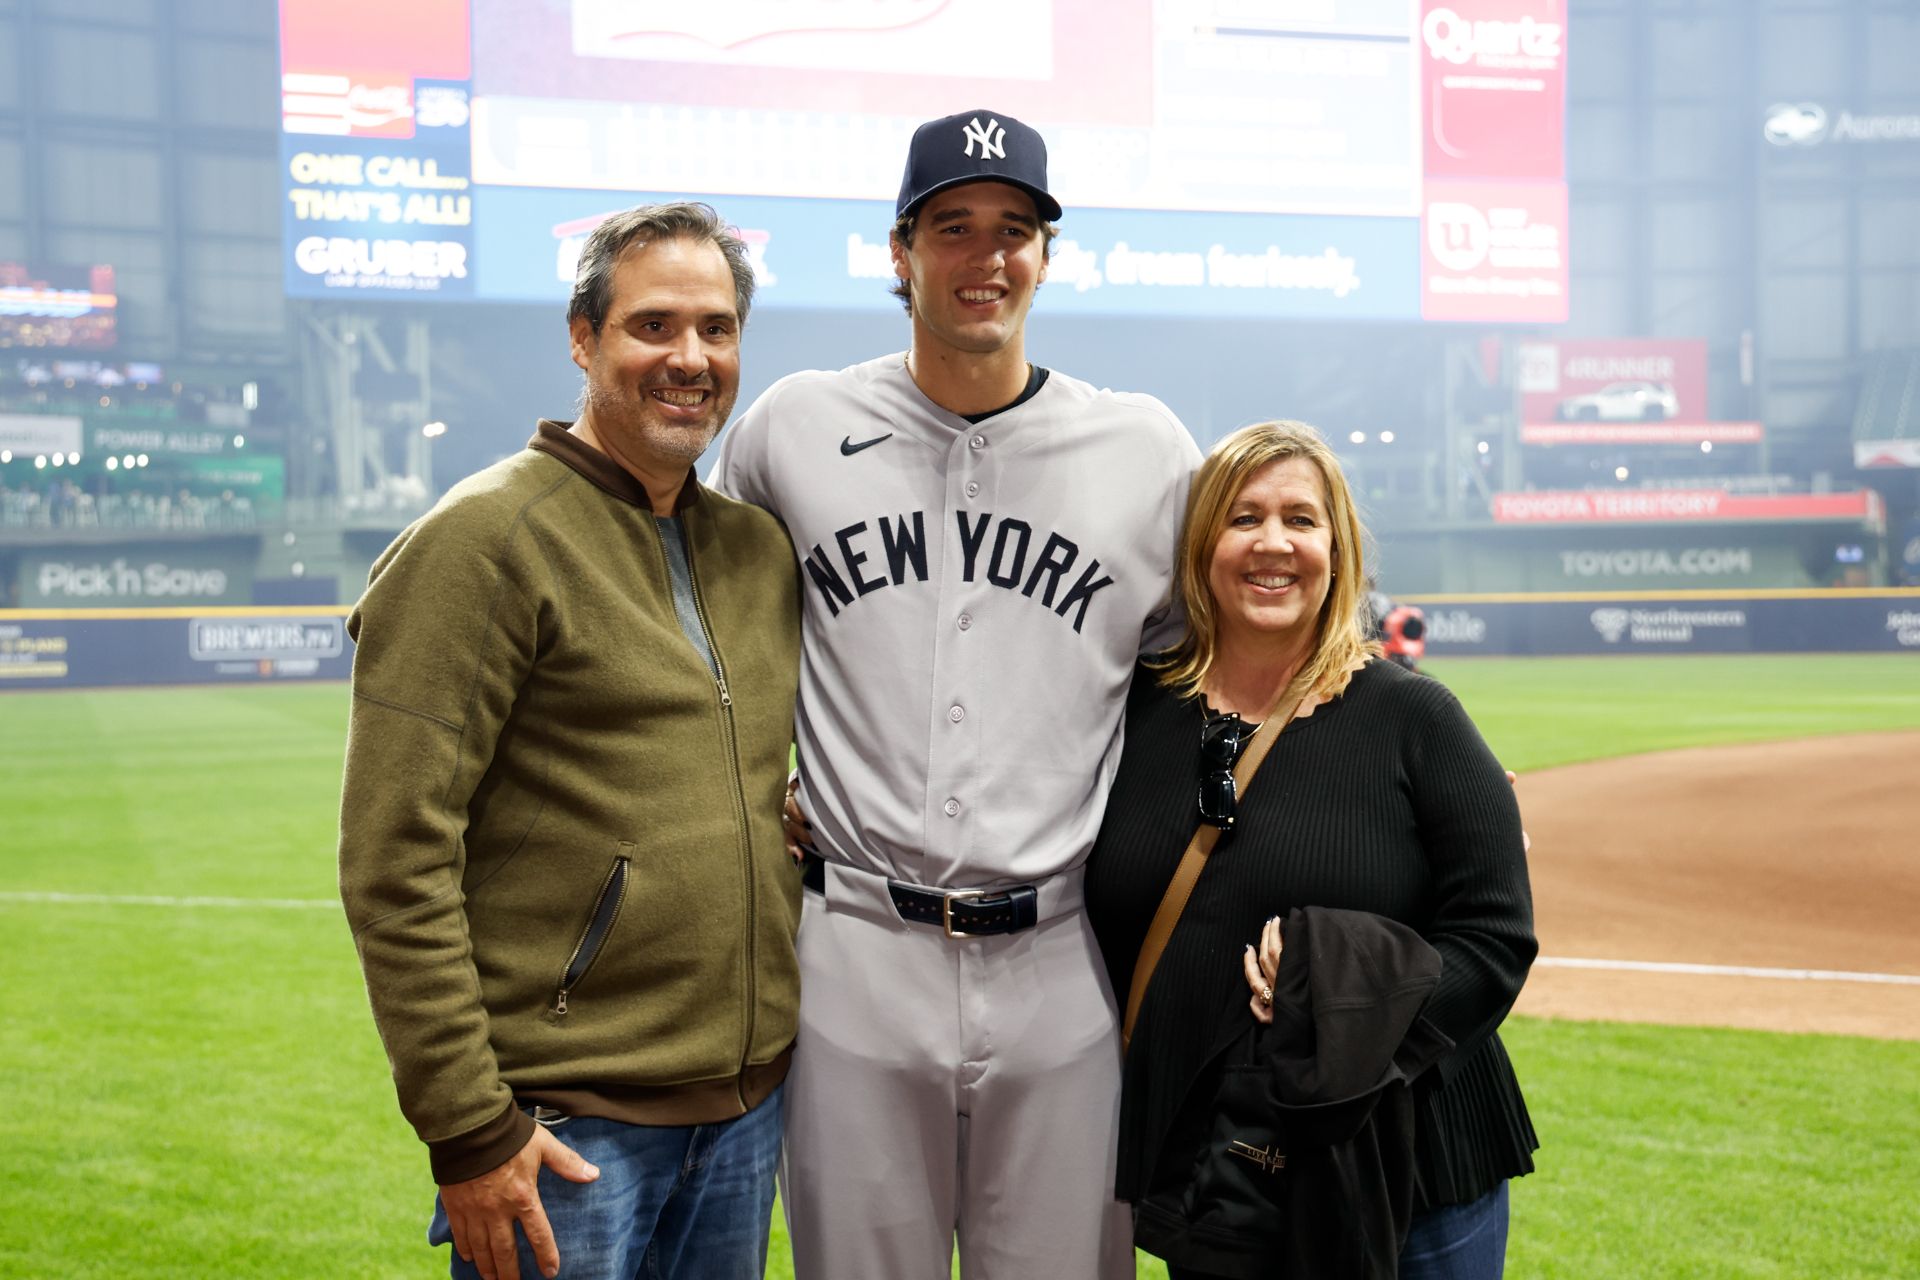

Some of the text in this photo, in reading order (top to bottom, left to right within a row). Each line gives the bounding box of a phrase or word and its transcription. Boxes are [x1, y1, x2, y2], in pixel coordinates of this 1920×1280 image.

[1423, 8, 1561, 64] Quartz
[962, 117, 1006, 160] NY
[290, 153, 363, 184] ONE
[295, 236, 467, 278] GRUBER
[1564, 355, 1674, 380] 4RUNNER
[93, 428, 225, 452] POWER ALLEY
[1499, 492, 1721, 519] TOYOTA TERRITORY
[804, 510, 1114, 634] NEW YORK
[1560, 549, 1752, 575] TOYOTA.COM
[143, 562, 228, 596] Save
[1631, 608, 1745, 627] Northwestern
[1631, 625, 1693, 642] Mutual
